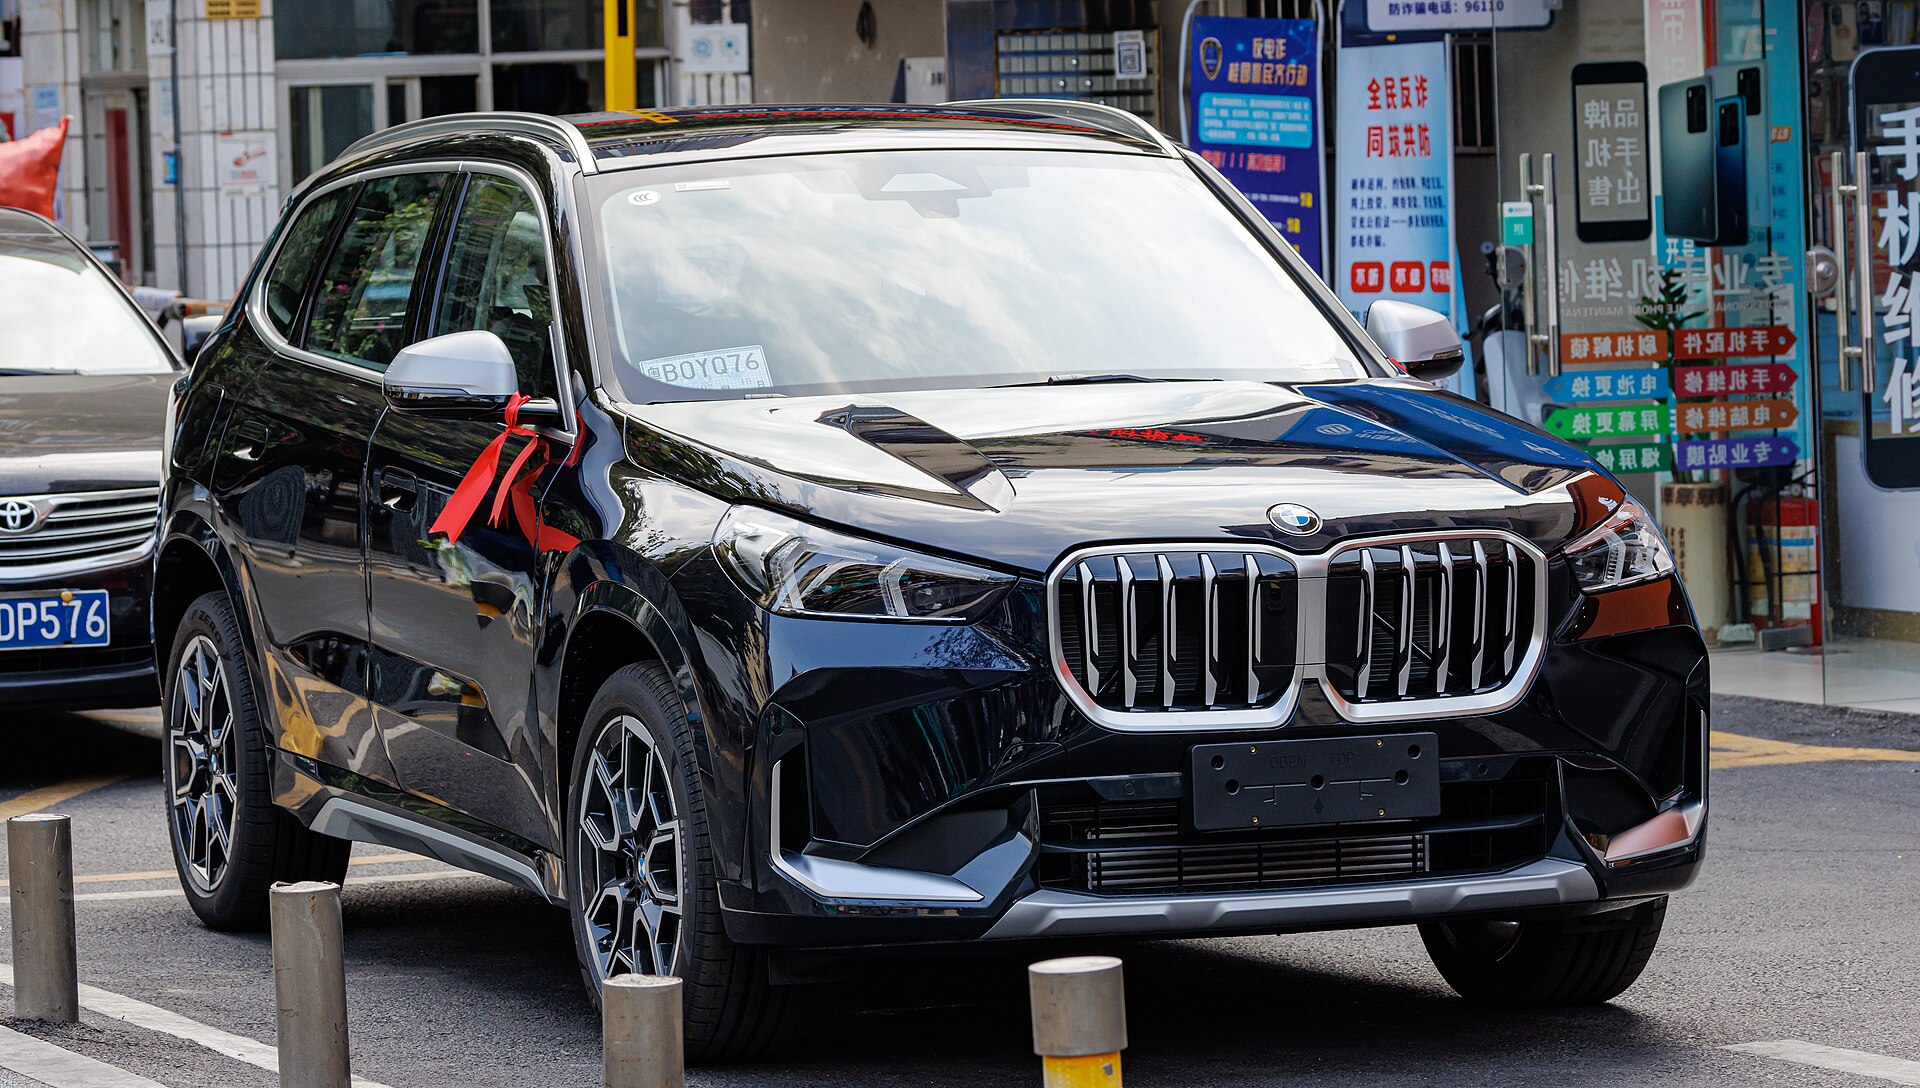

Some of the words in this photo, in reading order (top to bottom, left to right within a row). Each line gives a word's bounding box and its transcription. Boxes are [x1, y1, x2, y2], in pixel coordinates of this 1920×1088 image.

[1252, 37, 1287, 60] 反电诈
[1367, 75, 1428, 111] 全民反诈
[1366, 124, 1431, 158] 同筑共防
[1328, 750, 1355, 765] TOP
